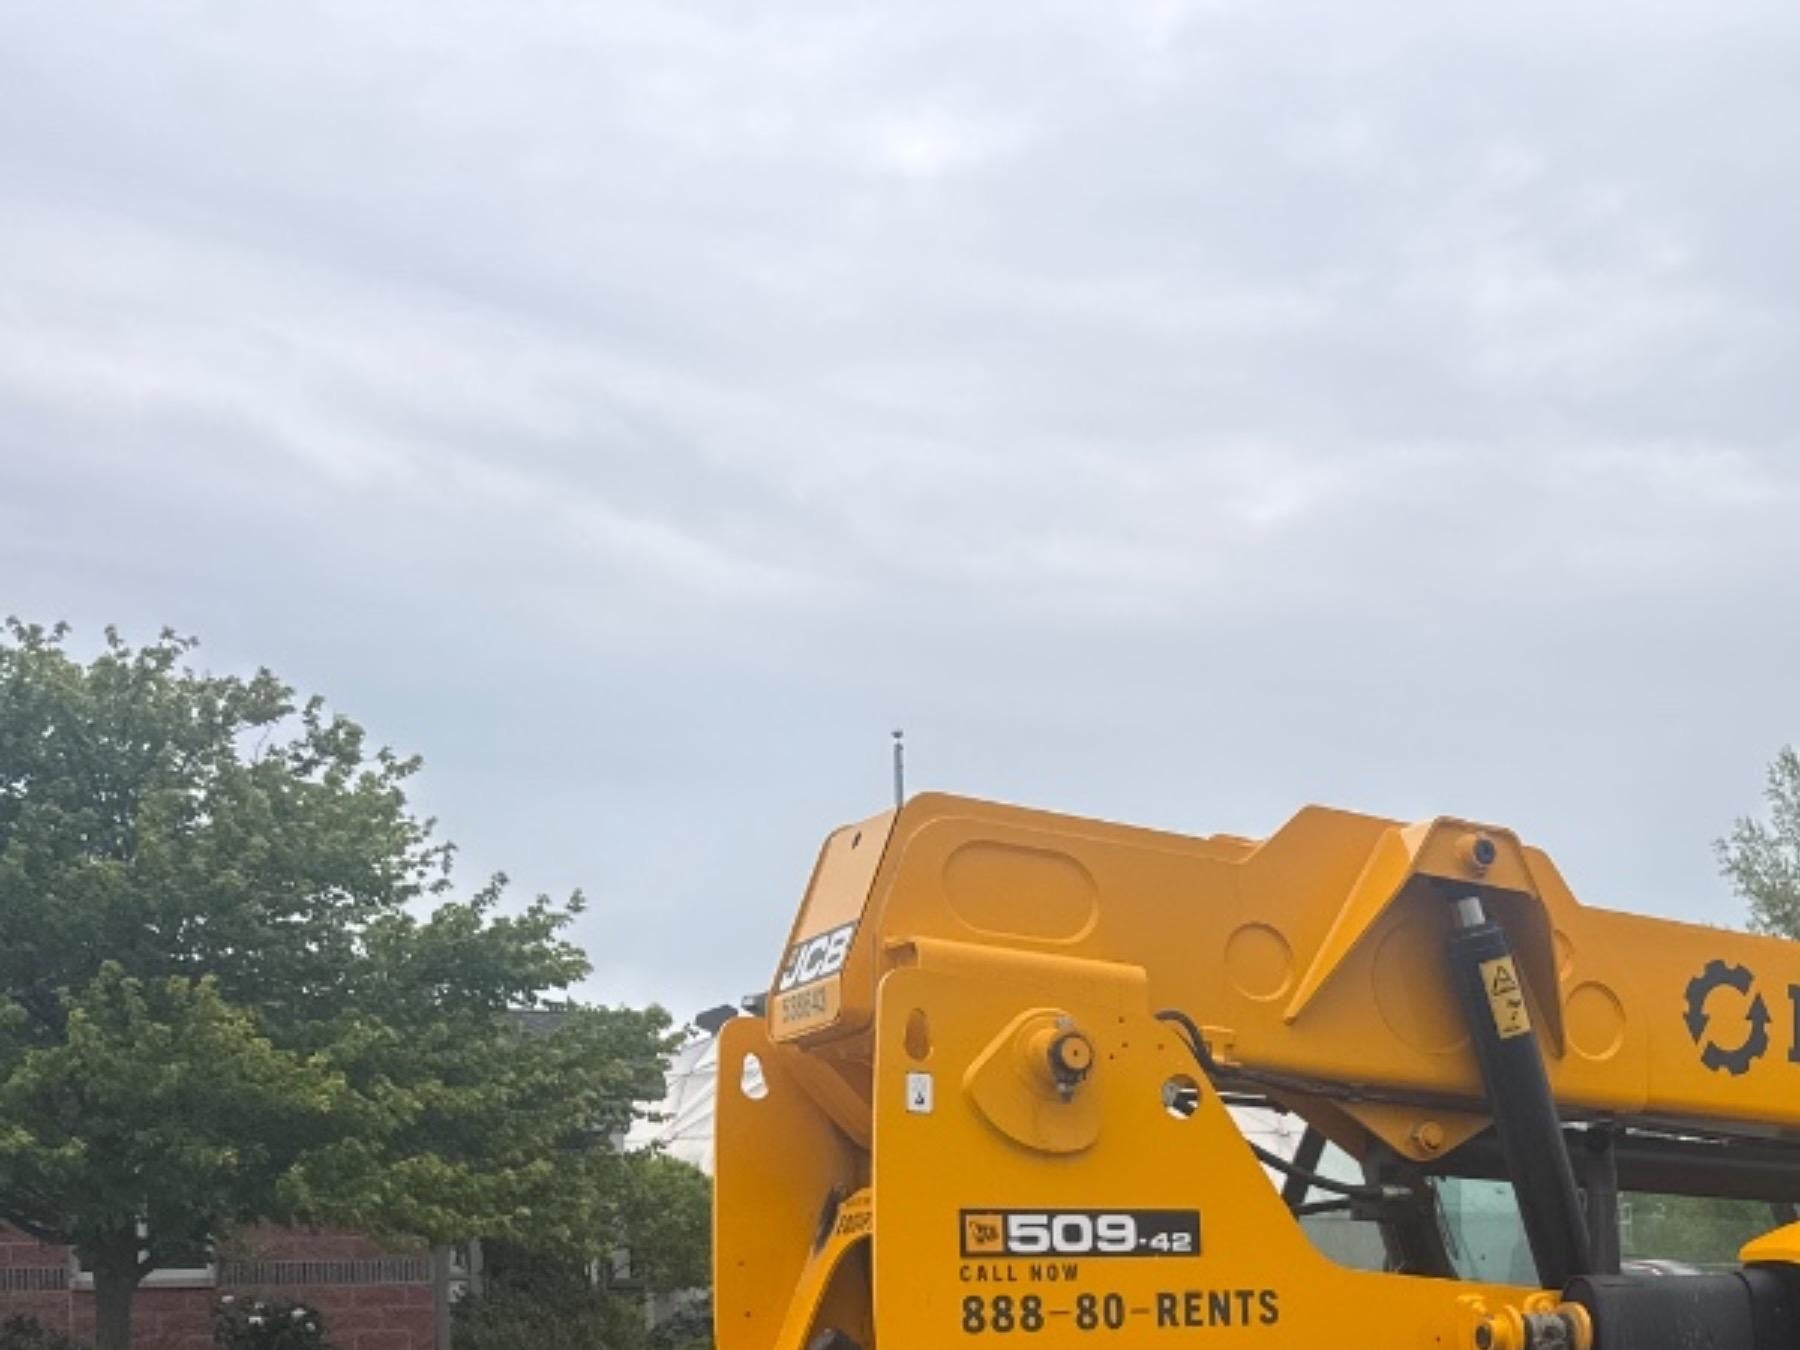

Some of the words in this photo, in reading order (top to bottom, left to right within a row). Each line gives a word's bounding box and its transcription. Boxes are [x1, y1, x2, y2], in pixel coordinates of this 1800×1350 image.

[780, 925, 855, 991] JCB
[960, 1265, 1017, 1282] CALL
[1030, 1264, 1079, 1281] NOW
[963, 1290, 1279, 1333] 888-80-RENTS
